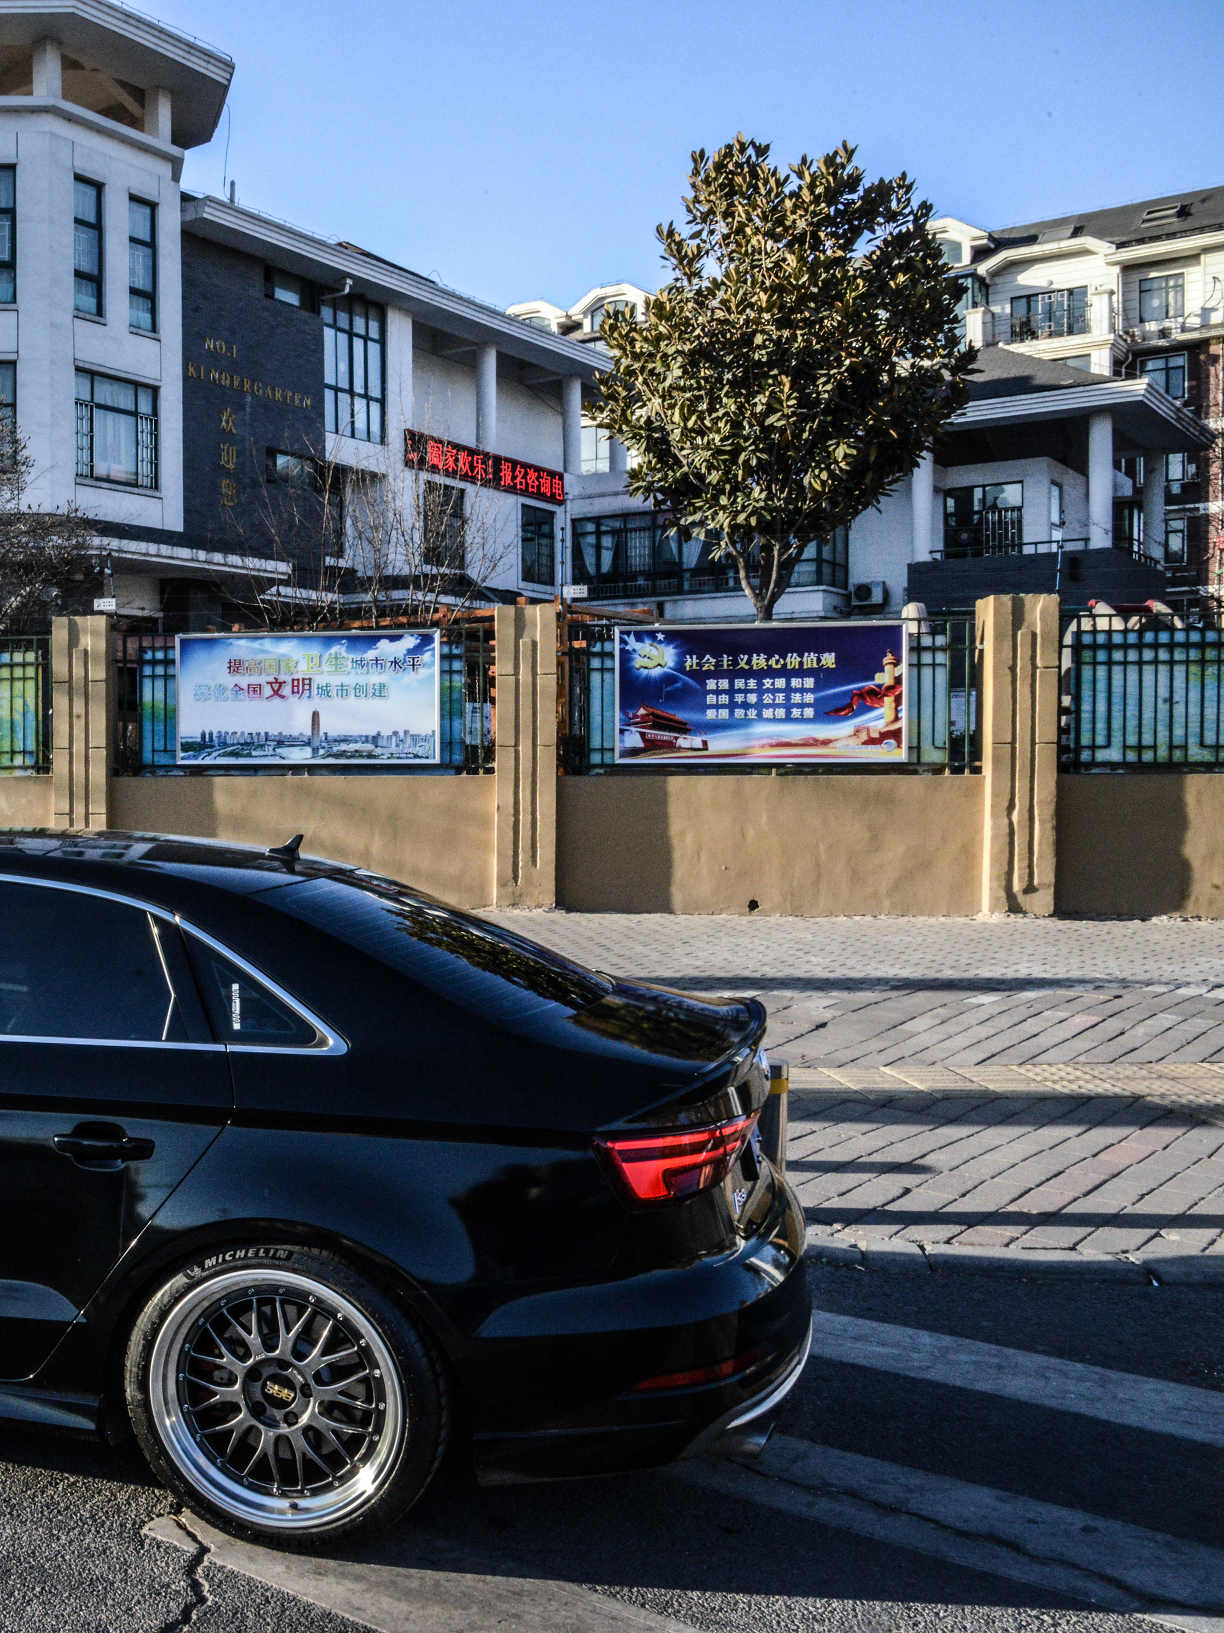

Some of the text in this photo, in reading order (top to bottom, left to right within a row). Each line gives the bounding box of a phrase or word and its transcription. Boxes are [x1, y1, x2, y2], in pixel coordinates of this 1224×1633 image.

[187, 362, 313, 410] KINDERGARTEN
[219, 407, 238, 506] 欢迎您
[226, 652, 424, 674] 提高国家卫生城市水平
[683, 652, 837, 672] 社会主义核心价值观
[705, 677, 815, 690] 富强 民主 文明 和谐
[705, 692, 815, 705] 自由 平等 公正 法治
[705, 707, 815, 720] 爱国 敬业 诚信 友善
[204, 1247, 289, 1269] MICHELIN
